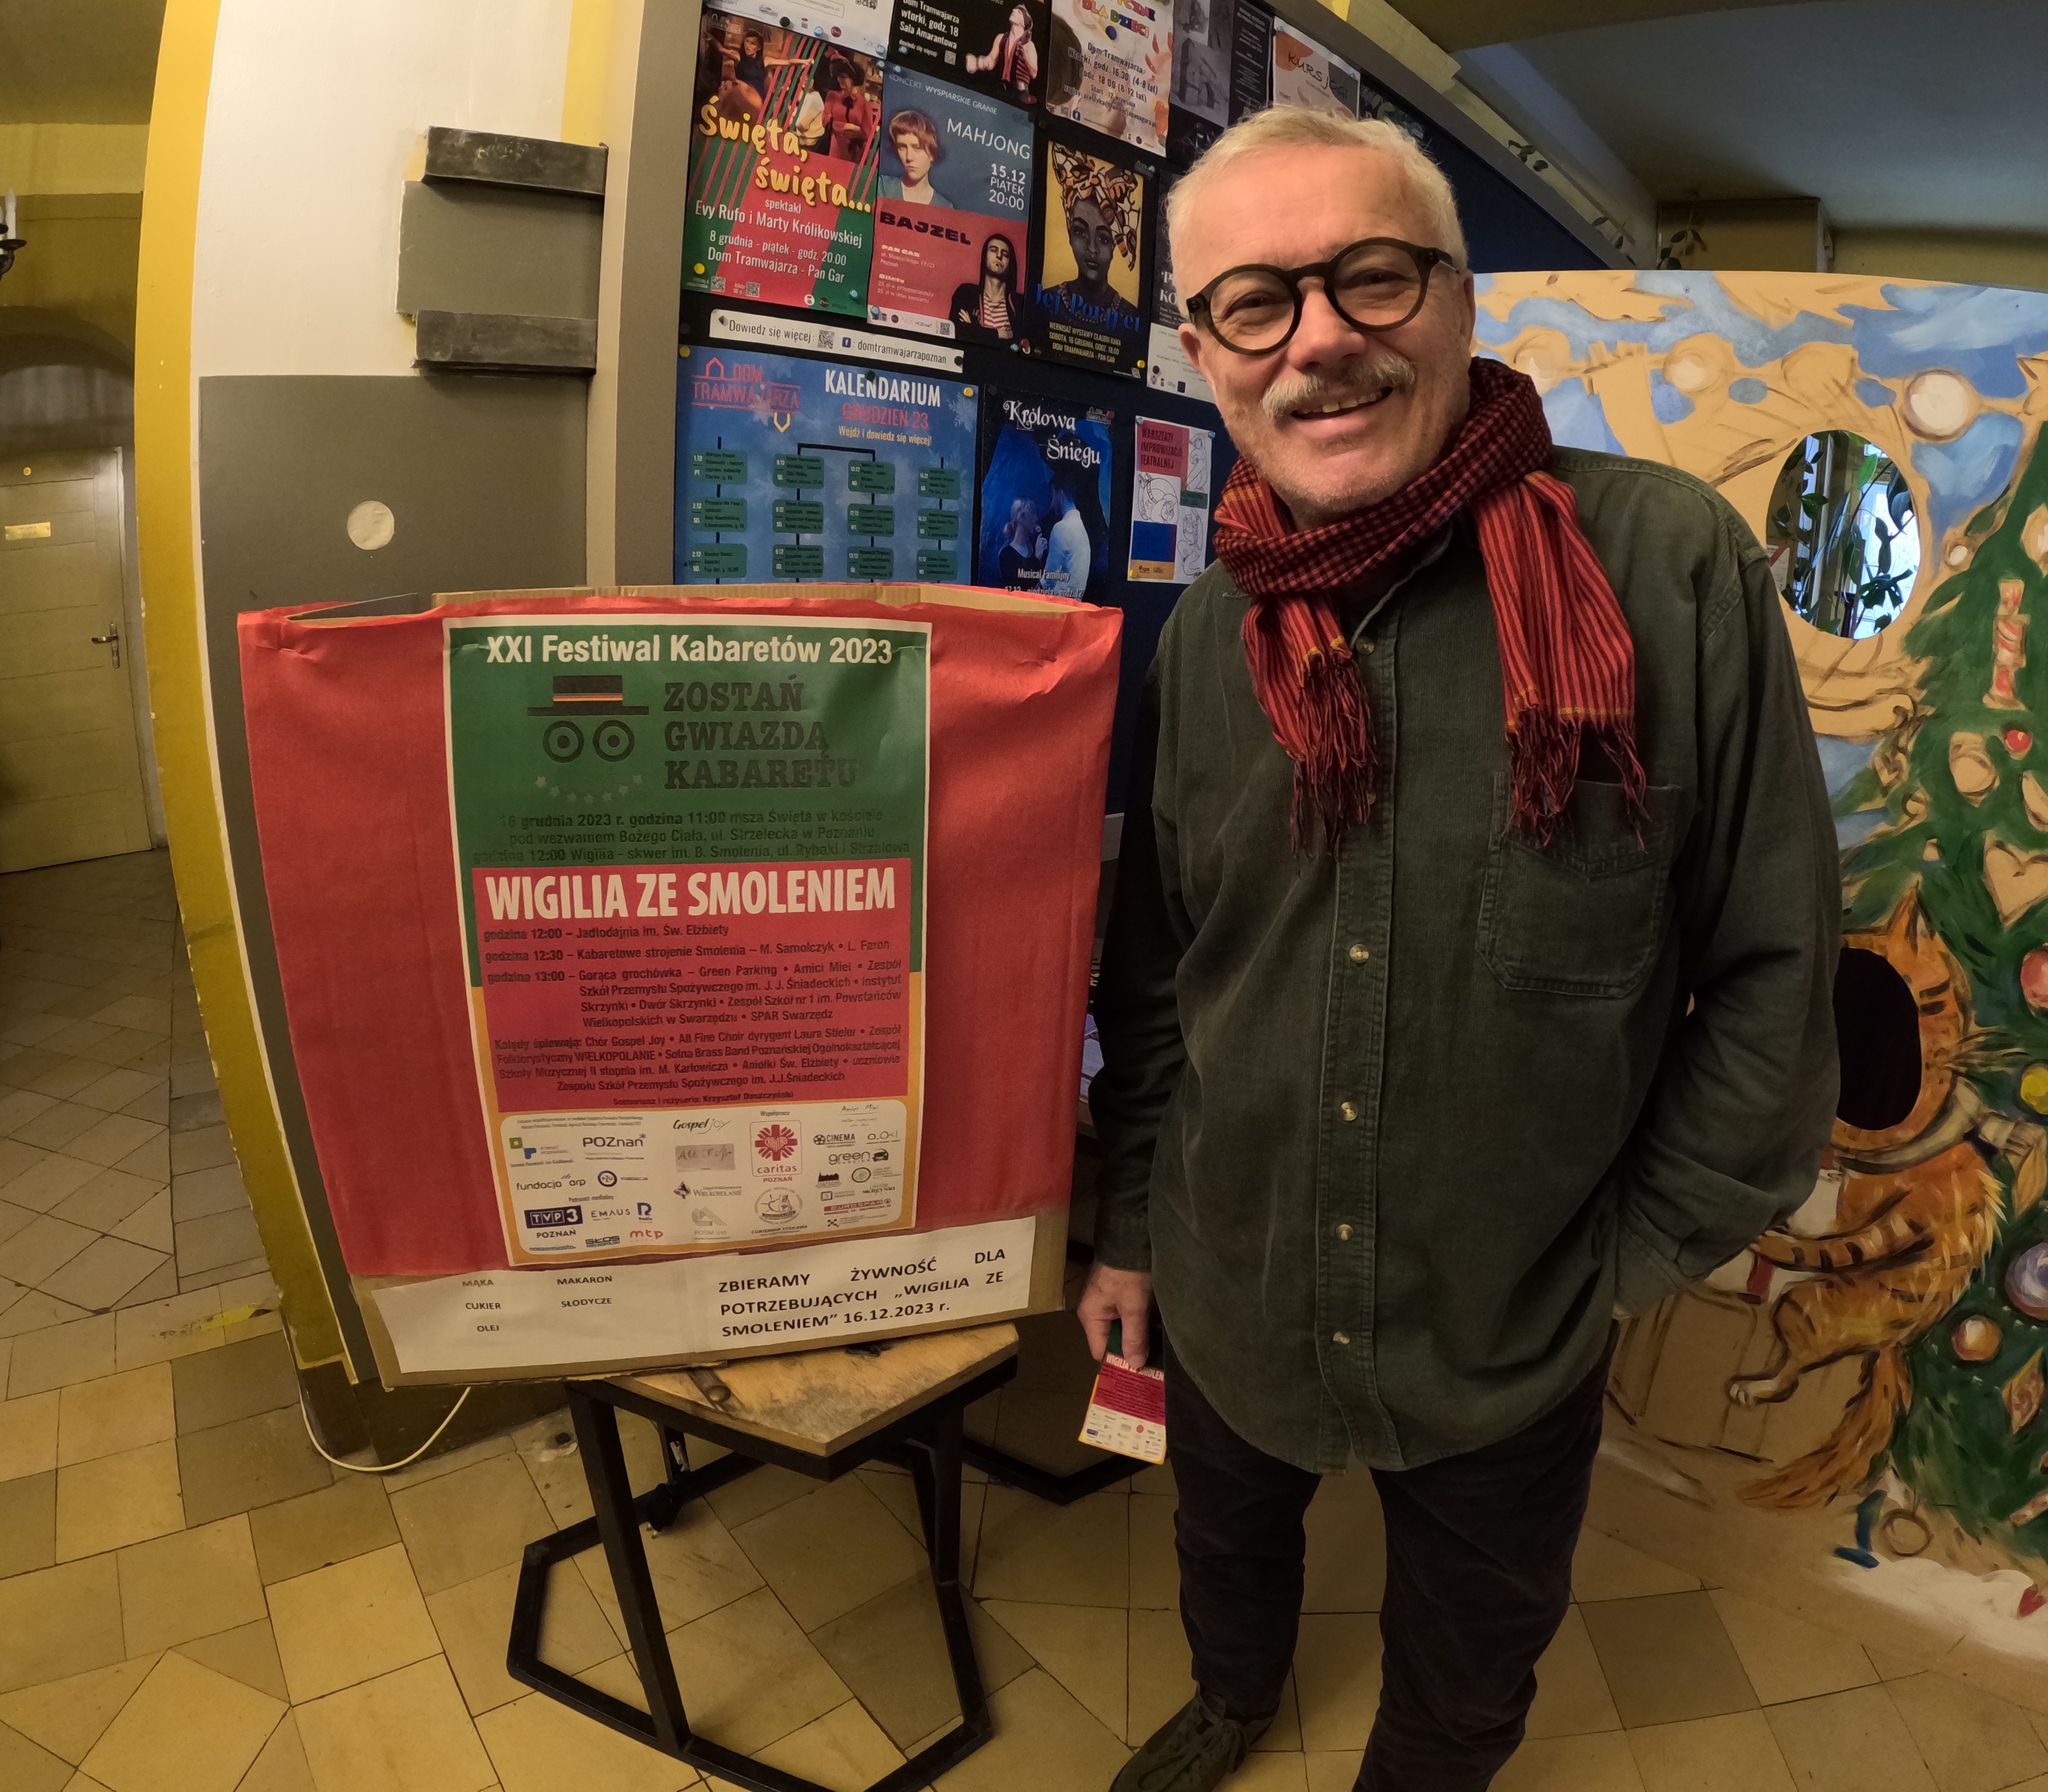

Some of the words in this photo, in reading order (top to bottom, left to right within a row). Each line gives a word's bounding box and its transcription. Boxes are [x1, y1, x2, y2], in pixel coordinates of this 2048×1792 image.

[920, 1, 960, 24] Tramwajarza
[950, 25, 959, 37] 18
[1287, 51, 1323, 82] KURS
[699, 95, 808, 162] Święta,
[946, 118, 1031, 160] MAHJONG
[991, 163, 1026, 185] 15.12
[990, 177, 1024, 197] PIĄTEK
[765, 199, 802, 215] spektakl
[988, 189, 1024, 211] 20:00
[695, 200, 715, 220] Evy
[718, 204, 746, 223] Rufo
[749, 210, 753, 224] i
[756, 215, 789, 234] Marty
[792, 219, 863, 249] Królikowskiej
[879, 211, 971, 246] BAJZEL
[709, 230, 717, 242] 8
[718, 232, 753, 248] grudnia
[762, 240, 790, 255] piątek
[822, 251, 847, 266] 20.00
[708, 247, 732, 262] Dom
[735, 251, 798, 275] Tramwajarza
[808, 265, 825, 280] Pan
[827, 268, 845, 283] Gar
[729, 319, 766, 336] Dowiedz
[768, 326, 782, 338] się
[857, 341, 948, 365] domtramwajarzapoznan
[825, 369, 941, 408] KALENDARIUM
[912, 411, 930, 431] 23
[1003, 400, 1077, 431] Królowa
[1046, 433, 1102, 469] Śniegu
[1017, 567, 1042, 579] Musical
[486, 635, 532, 663] XXI
[542, 634, 660, 663] Festiwal
[670, 634, 821, 663] Kabaretów
[829, 637, 893, 665] 2023
[663, 673, 805, 712] ZOSTAŃ
[663, 720, 830, 754] GWIAZDĄ
[664, 759, 858, 789] KABARETU
[520, 814, 574, 830] grudnia
[577, 814, 612, 827] 2023
[616, 815, 626, 826] r.
[629, 812, 683, 828] godzina
[688, 811, 726, 824] 11:00
[729, 812, 765, 824] msza
[768, 808, 813, 827] Święta
[817, 811, 828, 822] w
[509, 832, 534, 848] pod
[619, 829, 667, 846] Bożego
[729, 826, 798, 841] Strzelecka
[802, 829, 814, 840] w
[530, 849, 567, 863] 12:00
[571, 848, 615, 863] Wigilia
[627, 848, 669, 860] skwer
[485, 873, 629, 920] WIGILIA
[636, 873, 679, 918] ZE
[687, 867, 895, 916] SMOLENIEM
[483, 928, 528, 943] godzina
[531, 928, 563, 940] 12:00
[642, 926, 659, 937] im.
[662, 924, 684, 937] Św.
[485, 949, 529, 964] godzina
[533, 949, 564, 961] 12:30
[576, 948, 641, 960] Kabaretowe
[644, 947, 692, 960] strojenie
[695, 944, 746, 956] Smolenia
[759, 943, 773, 955] M.
[487, 970, 531, 985] godzina
[534, 970, 566, 982] 13:00
[578, 969, 617, 984] Gorąca
[621, 966, 682, 982] grochówka
[699, 965, 731, 977] Green
[735, 963, 778, 978] Parking
[578, 984, 610, 997] Szkół
[611, 983, 667, 998] Przemysłu
[669, 980, 744, 996] Spożywczego
[786, 976, 850, 990] Śniadeckich
[580, 1001, 629, 1014] Skrzynki
[639, 998, 667, 1010] Dwór
[669, 996, 717, 1010] Skrzynki
[727, 994, 763, 1008] Zespół
[582, 1014, 663, 1029] Wielkopolskich
[666, 1015, 677, 1025] w
[678, 1012, 738, 1026] Swarzędzu
[751, 1010, 779, 1021] SPAR
[782, 1008, 834, 1022] Swarzędz
[611, 1035, 646, 1048] Gospel
[648, 1034, 666, 1047] Joy
[749, 1030, 791, 1044] dyrygent
[794, 1029, 823, 1040] Laura
[574, 1049, 656, 1062] WIELKOPOLANIE
[695, 1046, 724, 1058] Brass
[672, 1118, 710, 1132] Gospel
[826, 1133, 856, 1142] CINEMA
[757, 1164, 798, 1174] caritas
[828, 1151, 871, 1165] green
[516, 1181, 562, 1191] fundacja
[536, 1228, 576, 1239] POZNAŃ
[630, 1229, 664, 1240] mtp
[557, 1275, 613, 1285] MAKARON
[718, 1273, 810, 1293] ZBIERAMY
[850, 1256, 937, 1282] ŻYWNOŚĆ
[974, 1248, 1006, 1265] DLA
[561, 1298, 612, 1308] SŁODYCZE
[720, 1289, 878, 1316] POTRZEBUJĄCYCH
[894, 1277, 970, 1298] „WIGILIA
[985, 1271, 1004, 1285] ZE
[465, 1302, 501, 1310] CUKIER
[843, 1302, 934, 1323] 16.12.2023
[938, 1302, 950, 1312] r.
[476, 1325, 500, 1333] OLEJ
